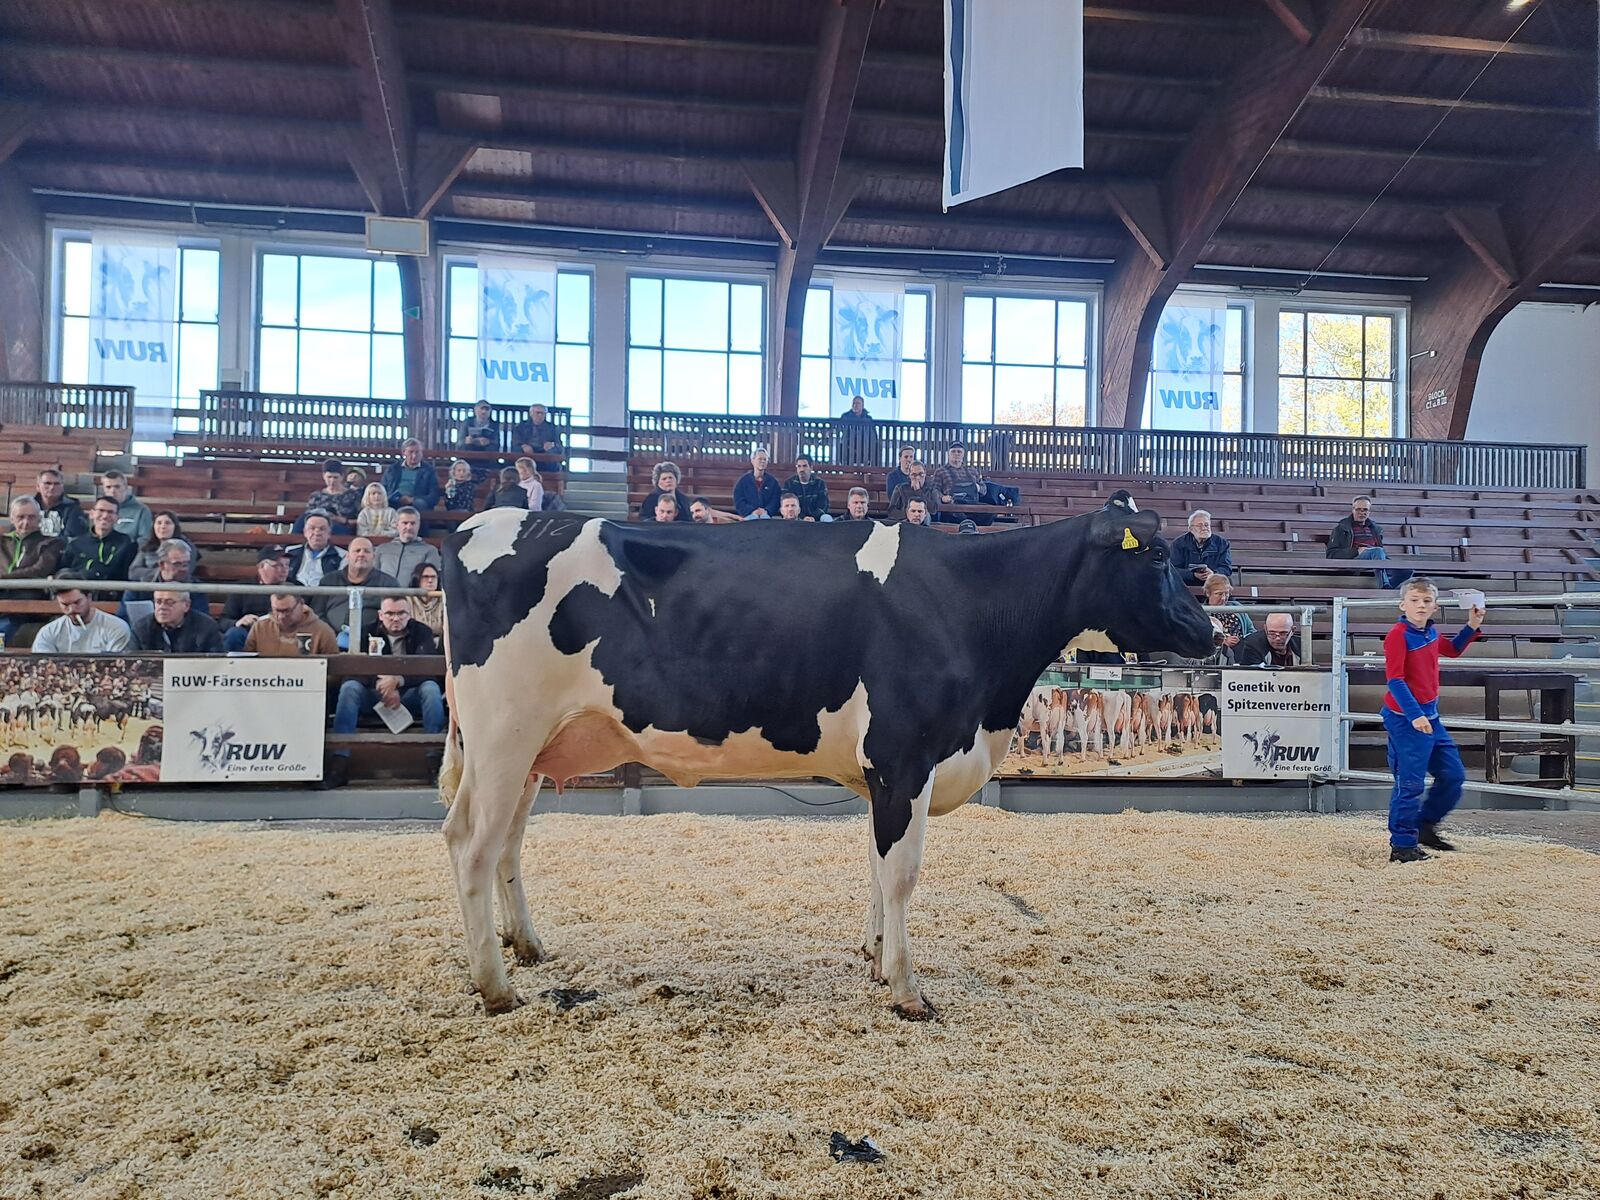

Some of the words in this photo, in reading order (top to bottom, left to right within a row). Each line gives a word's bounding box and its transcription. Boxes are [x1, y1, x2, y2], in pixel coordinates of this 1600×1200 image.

[171, 674, 304, 687] RUW-Färsenschau
[1227, 681, 1275, 693] Genetik
[1277, 684, 1301, 694] von
[1227, 698, 1331, 713] Spitzenvererbern
[226, 743, 287, 760] RUW
[1273, 745, 1320, 762] RUW
[227, 764, 247, 772] Eine
[249, 763, 275, 773] feste
[278, 764, 307, 772] Größe
[1274, 764, 1291, 772] Eine
[1292, 764, 1312, 773] feste
